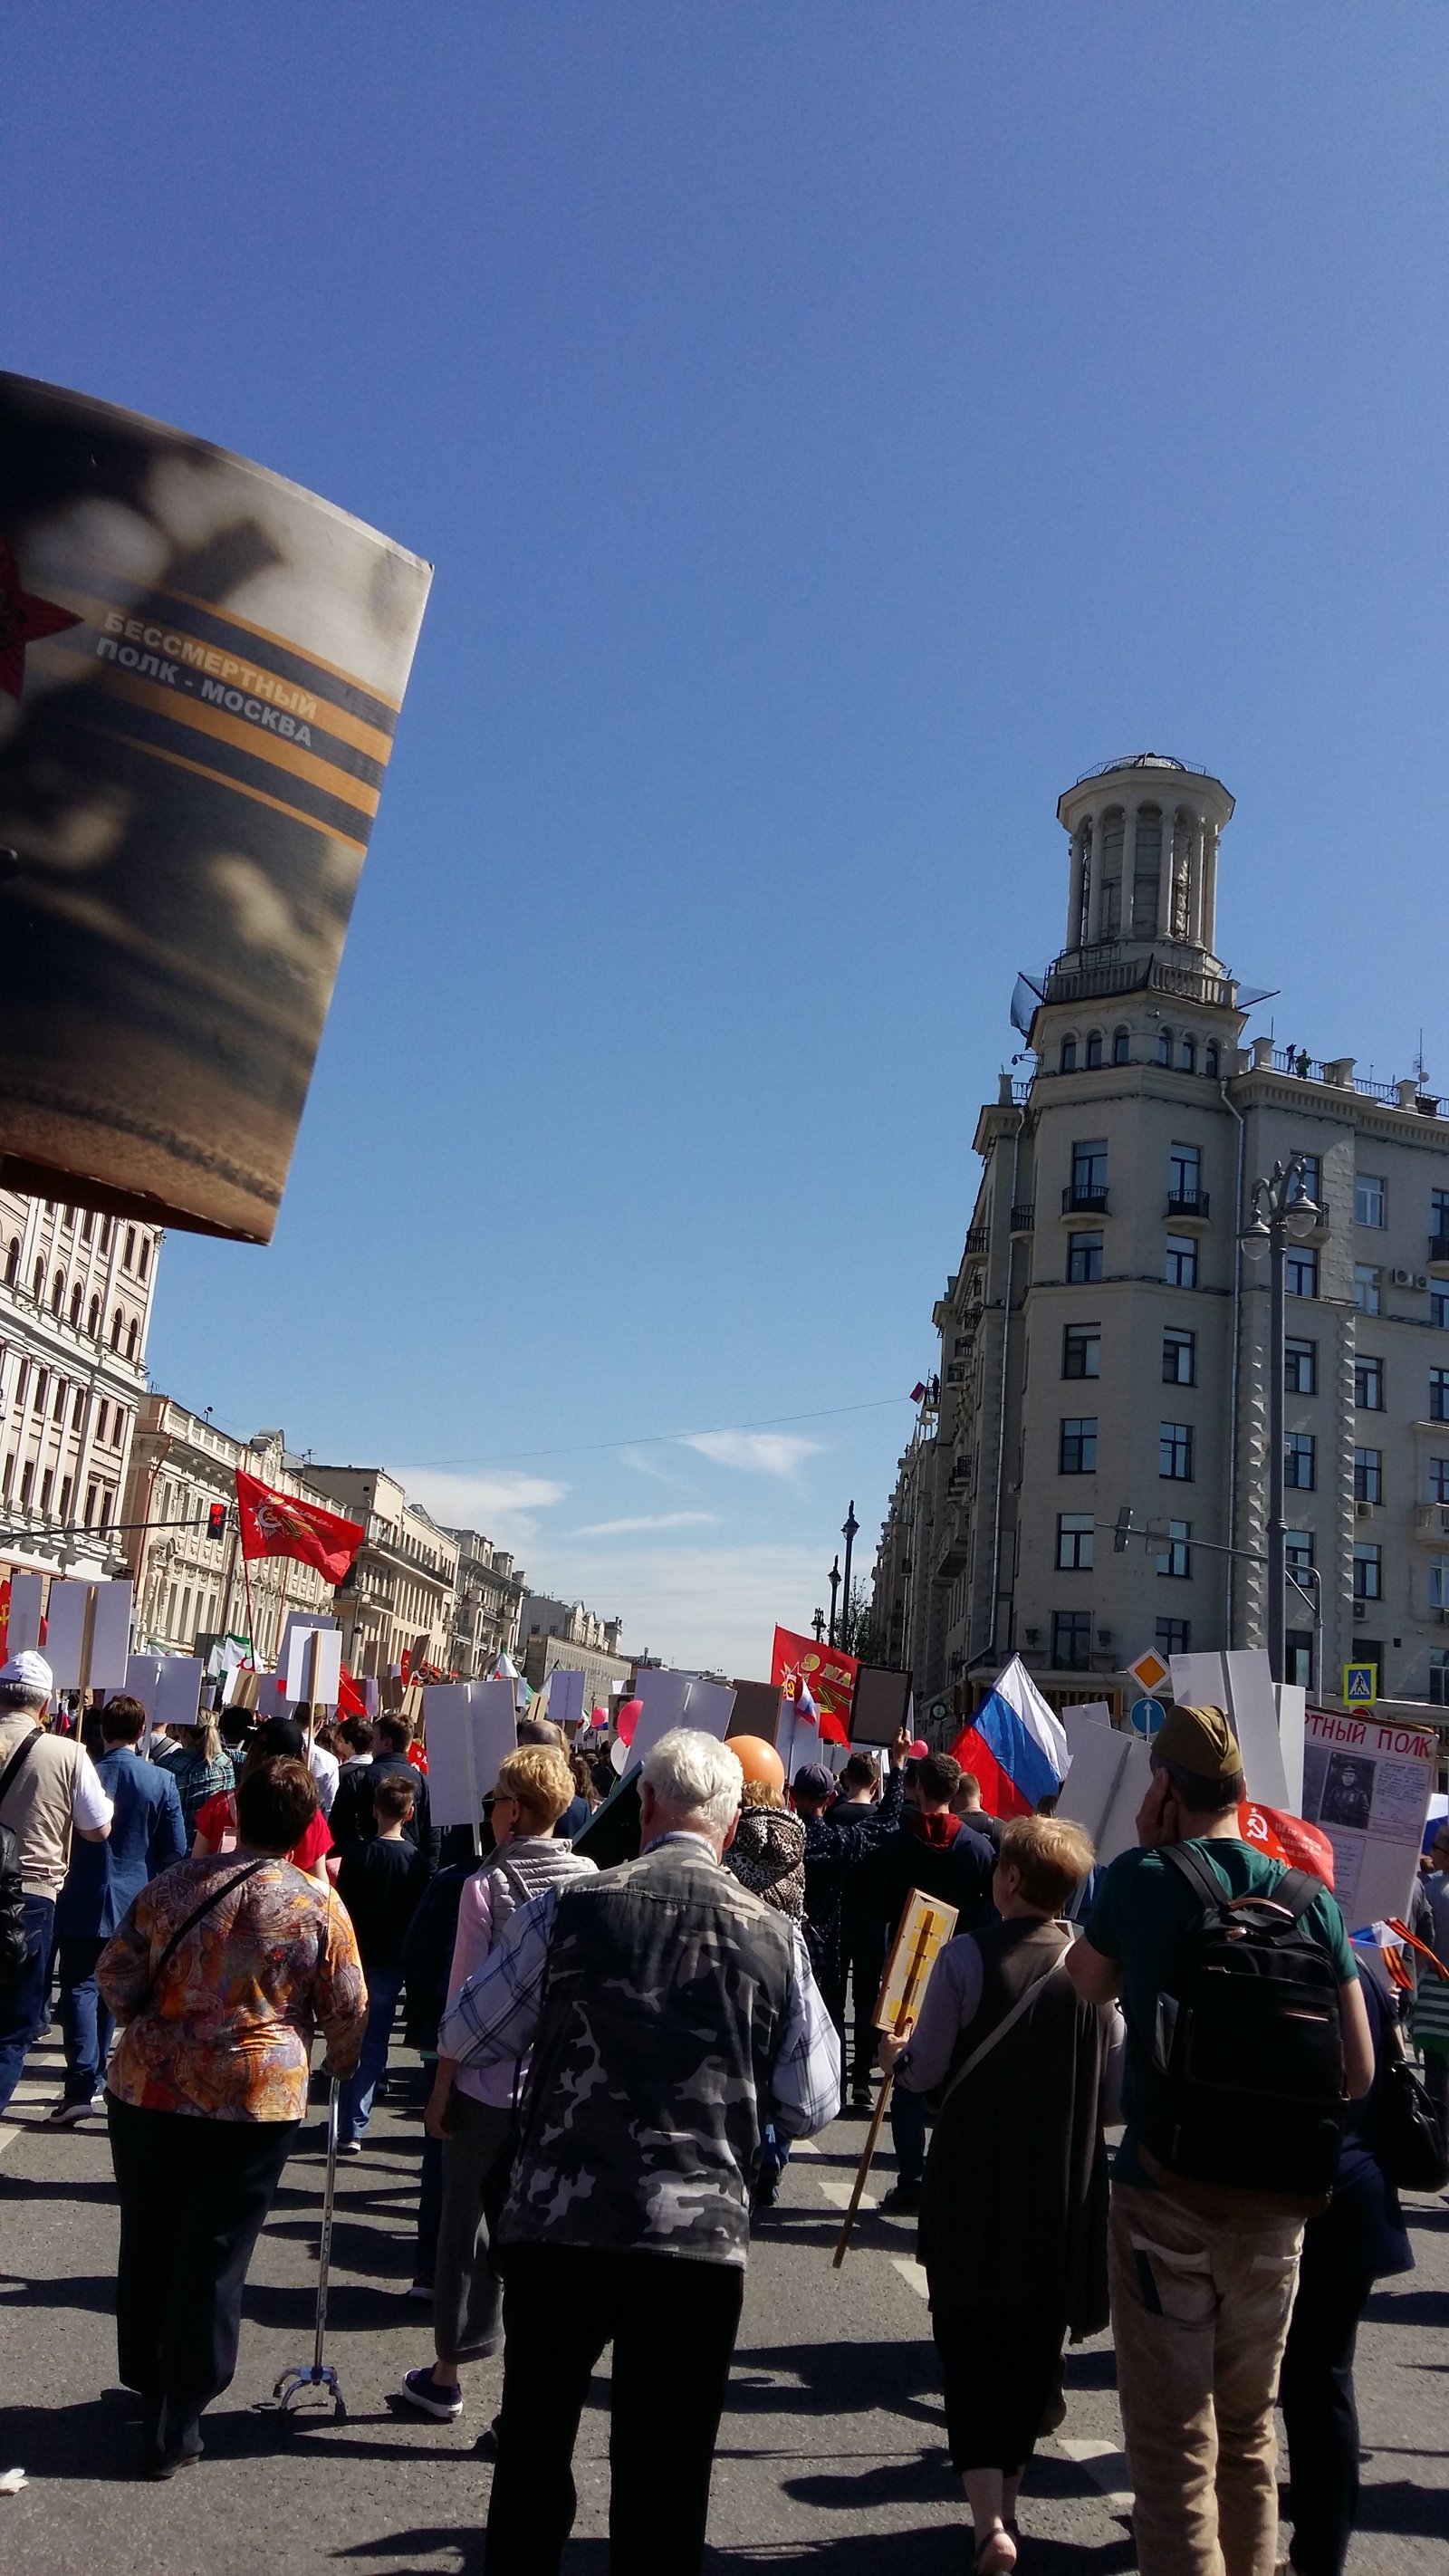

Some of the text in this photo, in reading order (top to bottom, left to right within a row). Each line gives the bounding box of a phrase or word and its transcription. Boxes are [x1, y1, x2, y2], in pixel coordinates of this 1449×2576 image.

[96, 637, 179, 685] ПОЛК
[201, 678, 312, 747] МОСКВА
[104, 611, 317, 720] БЕССМЕРТНЫЙ
[801, 1653, 855, 1691] 9 МА
[1377, 1728, 1433, 1759] ПОЛК
